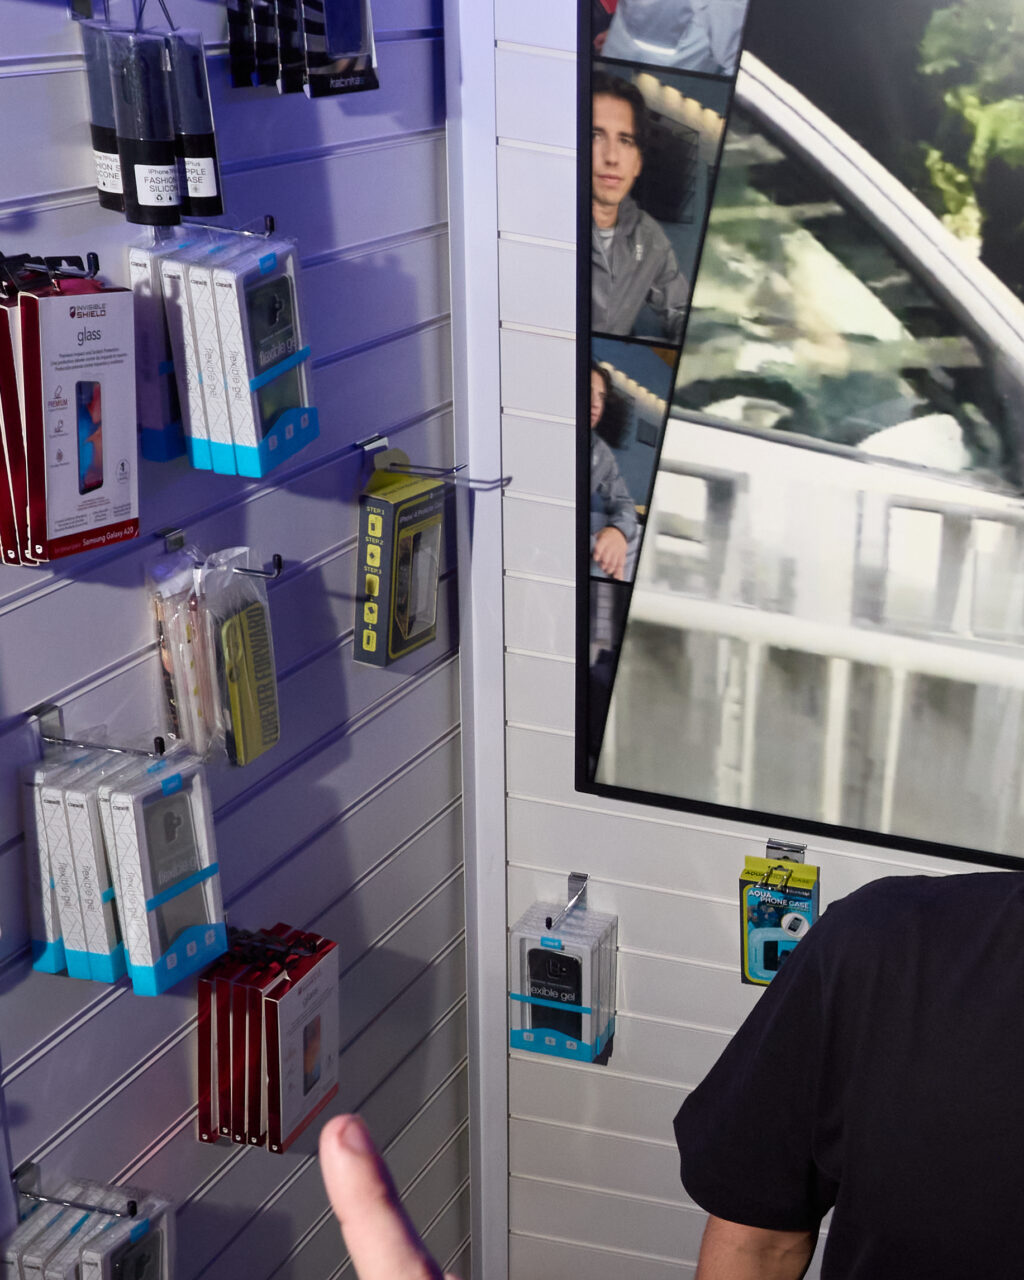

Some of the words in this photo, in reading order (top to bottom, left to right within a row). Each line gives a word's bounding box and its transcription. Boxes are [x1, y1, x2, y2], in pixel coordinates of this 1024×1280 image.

[77, 310, 106, 318] SHIELD
[77, 327, 101, 346] glass
[259, 341, 287, 366] flexible
[48, 399, 68, 407] PREMIUM
[82, 533, 106, 546] Samsung
[107, 531, 123, 540] Galaxy
[124, 526, 134, 535] A20
[246, 605, 273, 682] FORWARD
[257, 679, 279, 746] FOREVER
[748, 890, 771, 898] AQUA
[760, 897, 788, 906] PHONE
[789, 901, 809, 909] CASE
[531, 985, 558, 998] exible
[561, 989, 576, 1001] gel
